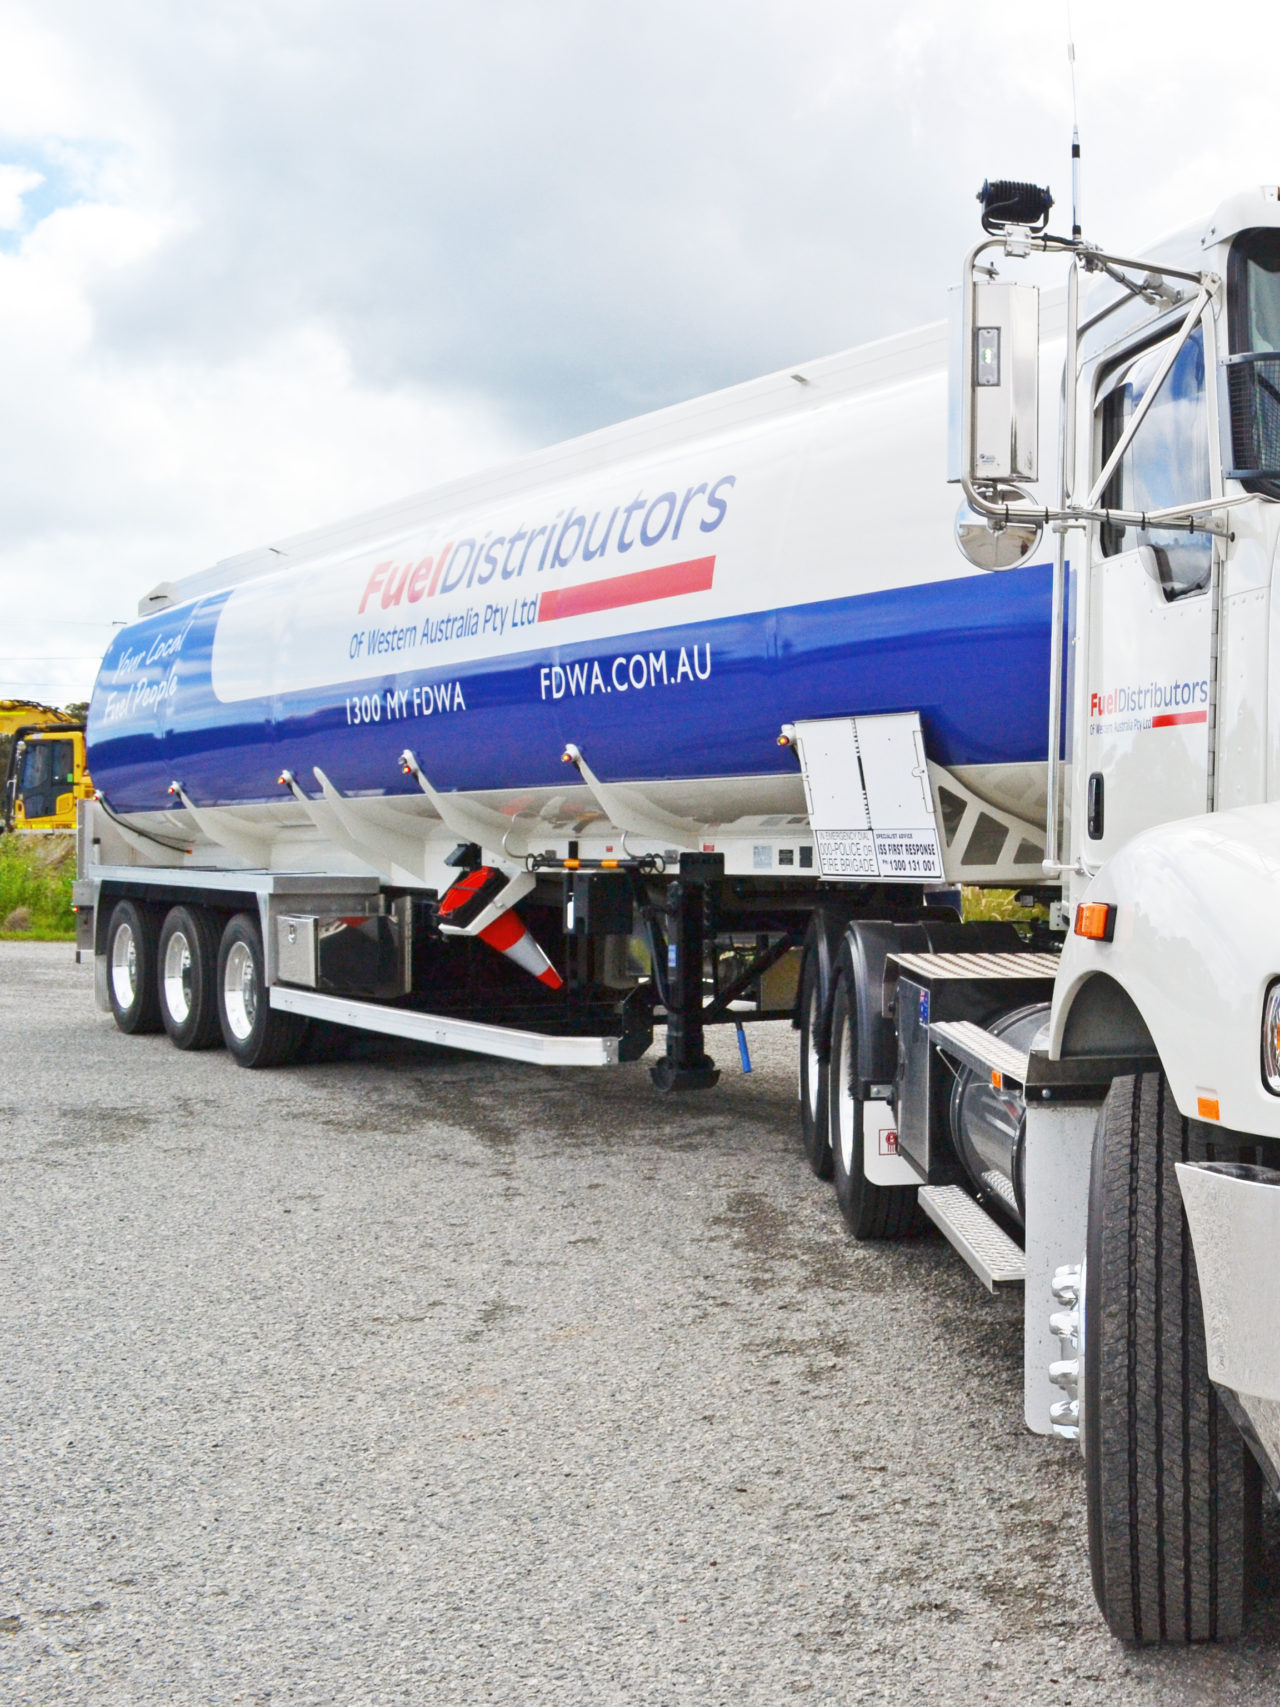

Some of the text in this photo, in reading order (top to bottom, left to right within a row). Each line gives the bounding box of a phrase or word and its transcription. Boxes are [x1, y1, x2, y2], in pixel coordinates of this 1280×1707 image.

[358, 475, 737, 614] FuelDistributors
[146, 619, 194, 665] Local
[368, 625, 417, 656] Western
[420, 608, 479, 646] Australia
[483, 604, 508, 636] Pty
[512, 593, 539, 628] Ltd
[540, 643, 711, 700] FDWA.COM.AU
[346, 681, 466, 725] 1300 MY FDWA
[1090, 680, 1208, 717] FuelDistributors
[821, 858, 876, 872] FIRE BRIGADE
[888, 844, 905, 855] FIRST
[905, 844, 936, 856] RESPONSE
[889, 859, 907, 871] 1300
[907, 860, 921, 871] 131
[923, 859, 936, 871] 001
